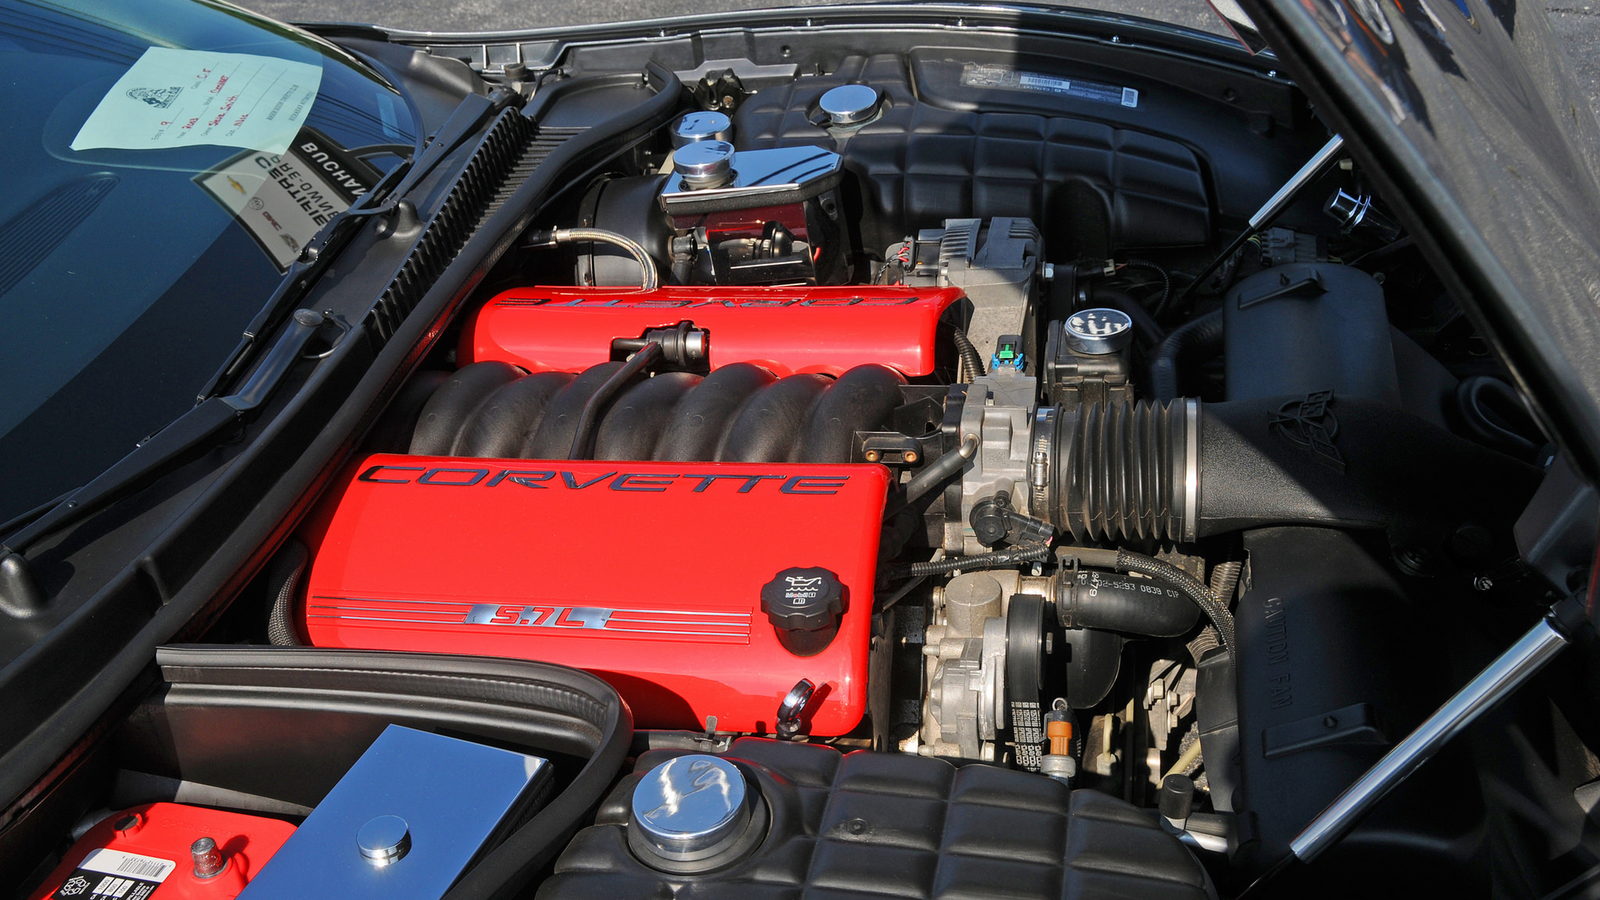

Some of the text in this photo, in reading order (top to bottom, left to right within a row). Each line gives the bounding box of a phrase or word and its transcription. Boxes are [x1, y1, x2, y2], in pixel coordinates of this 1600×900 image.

[358, 464, 850, 495] CORVETTE
[490, 605, 585, 628] 5.7L
[1263, 597, 1293, 710] CAUTION FAN
